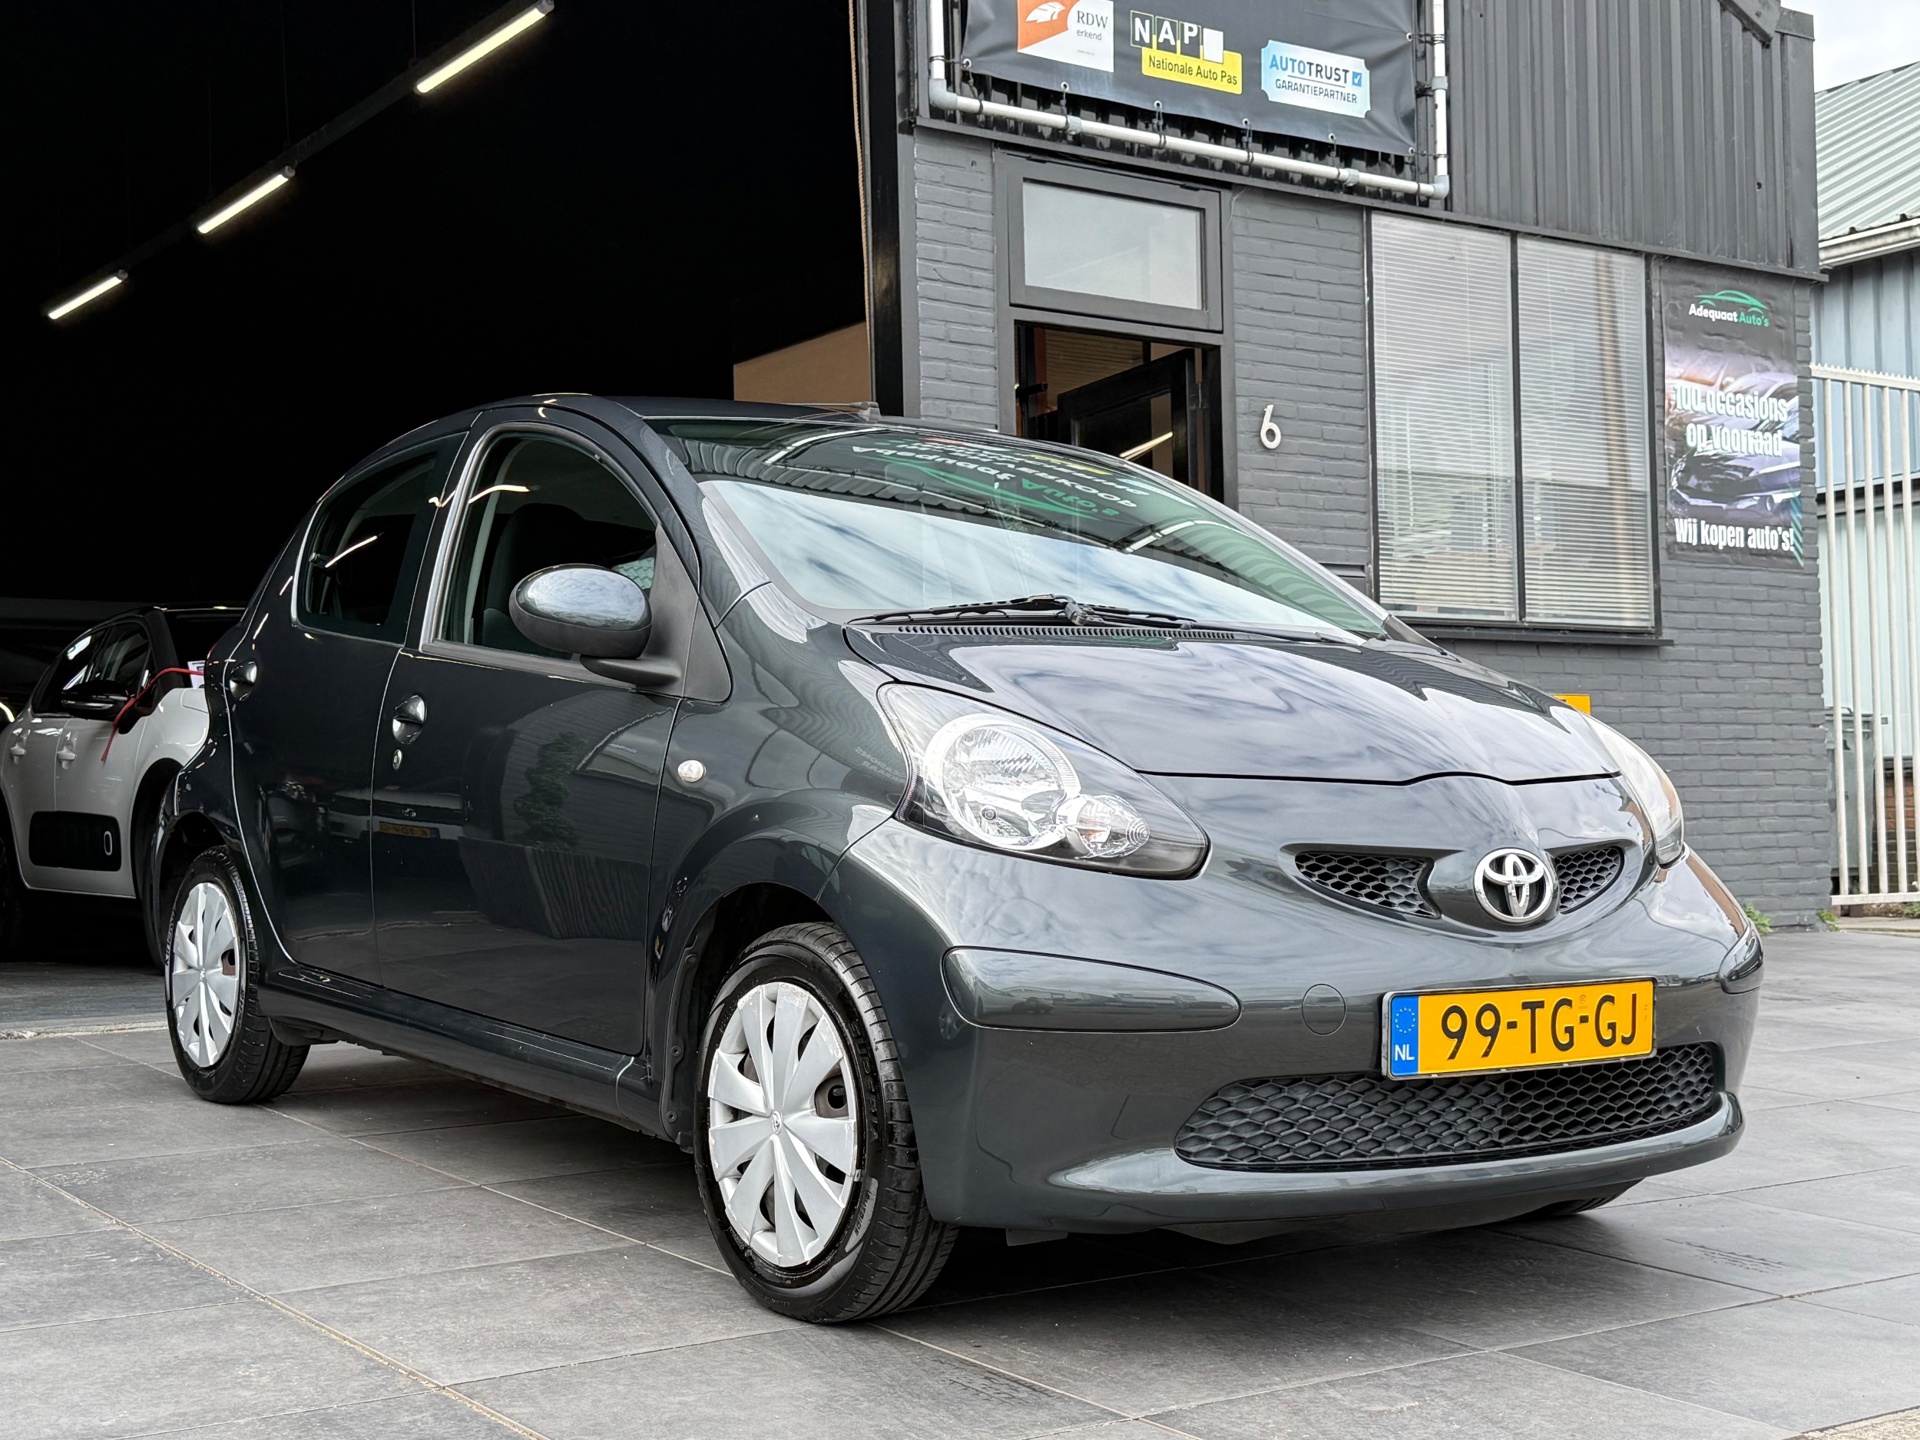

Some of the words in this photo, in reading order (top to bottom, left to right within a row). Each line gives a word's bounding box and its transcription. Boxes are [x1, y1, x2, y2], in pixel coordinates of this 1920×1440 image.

[1076, 10, 1109, 30] RDW
[1076, 28, 1102, 42] erkend
[1134, 16, 1199, 46] NAP
[1148, 54, 1194, 77] Nationale
[1195, 64, 1219, 82] Auto
[1220, 70, 1238, 86] Pas
[1269, 54, 1350, 85] AUTOTRUST
[1275, 78, 1358, 104] GARANTIEPARTNER
[1688, 303, 1738, 322] Adequaat
[1738, 312, 1770, 328] Auto's
[1674, 384, 1702, 413] 100
[1705, 389, 1788, 422] occasions
[1260, 404, 1282, 450] 6
[1685, 422, 1708, 452] op
[1710, 425, 1783, 457] voorraad
[1673, 518, 1698, 546] Wij
[1700, 520, 1745, 550] kopen
[1747, 527, 1795, 553] auto's!
[1441, 993, 1637, 1061] 99-TG-GJ
[1394, 1044, 1415, 1061] NL
